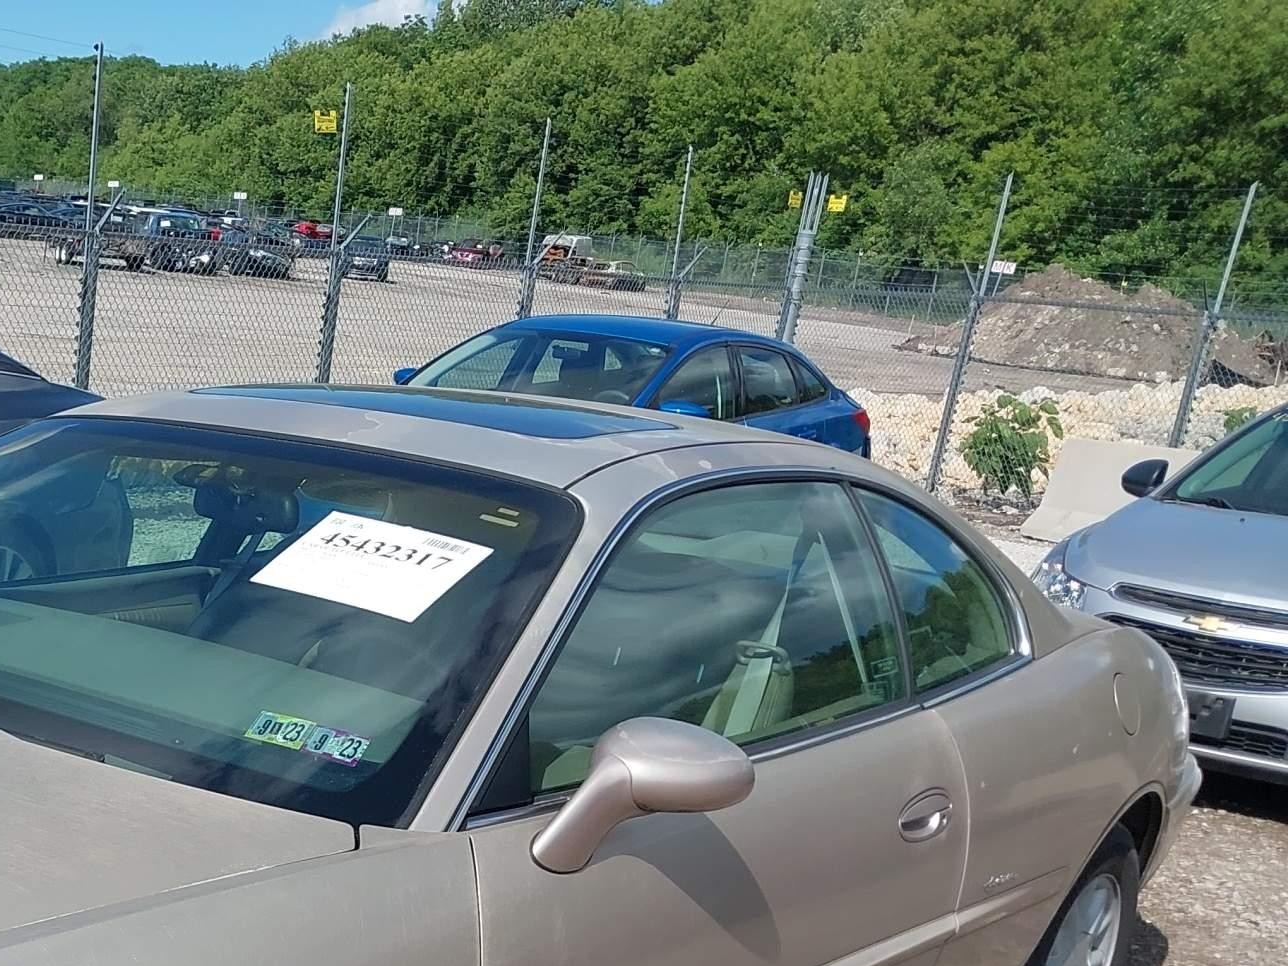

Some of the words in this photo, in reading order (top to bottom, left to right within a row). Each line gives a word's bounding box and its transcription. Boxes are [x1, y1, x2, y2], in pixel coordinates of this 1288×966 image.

[319, 531, 454, 570] 45432317
[282, 722, 306, 742] 23
[338, 738, 362, 759] 23
